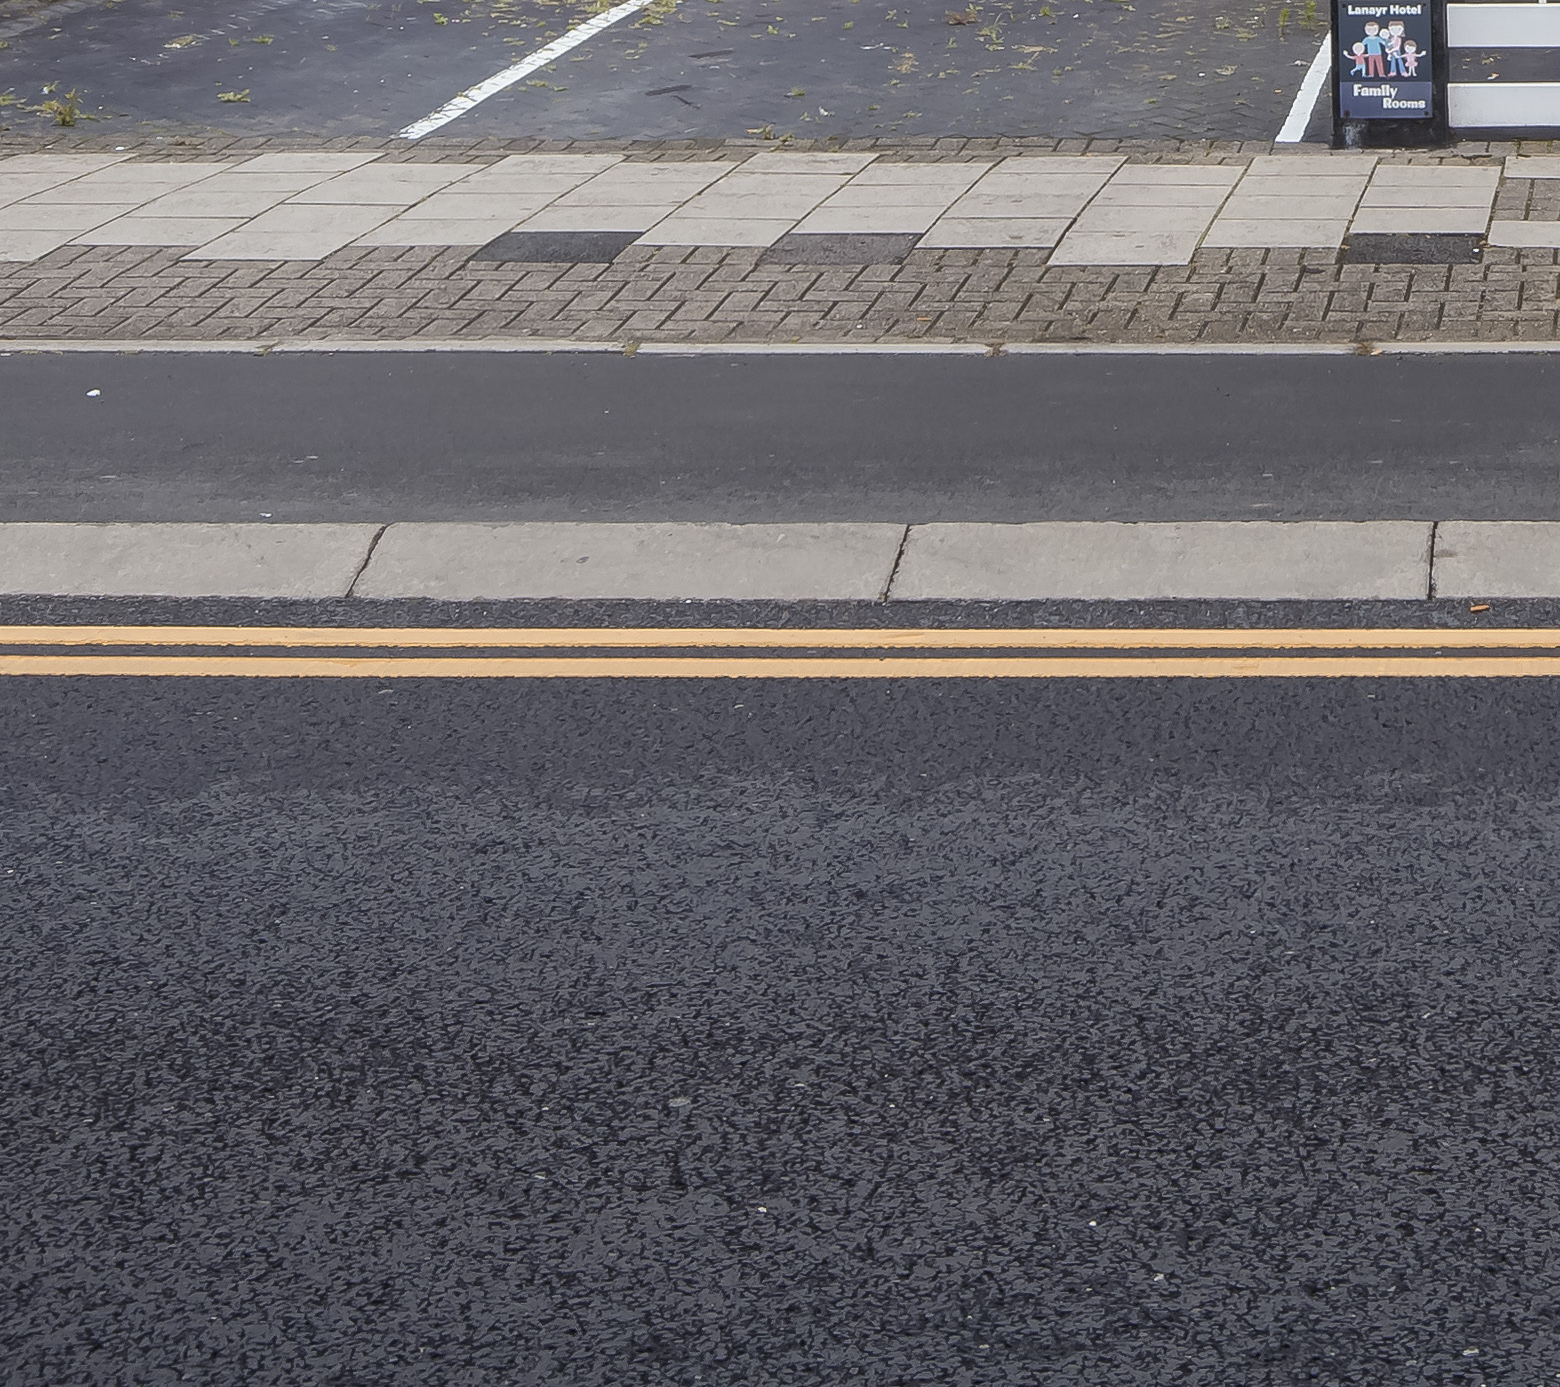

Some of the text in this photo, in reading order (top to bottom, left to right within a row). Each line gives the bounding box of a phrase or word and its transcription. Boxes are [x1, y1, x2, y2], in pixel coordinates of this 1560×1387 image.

[1348, 5, 1422, 17] Lanayr Hotel
[1353, 84, 1398, 99] Family
[1382, 98, 1426, 109] Rooms
